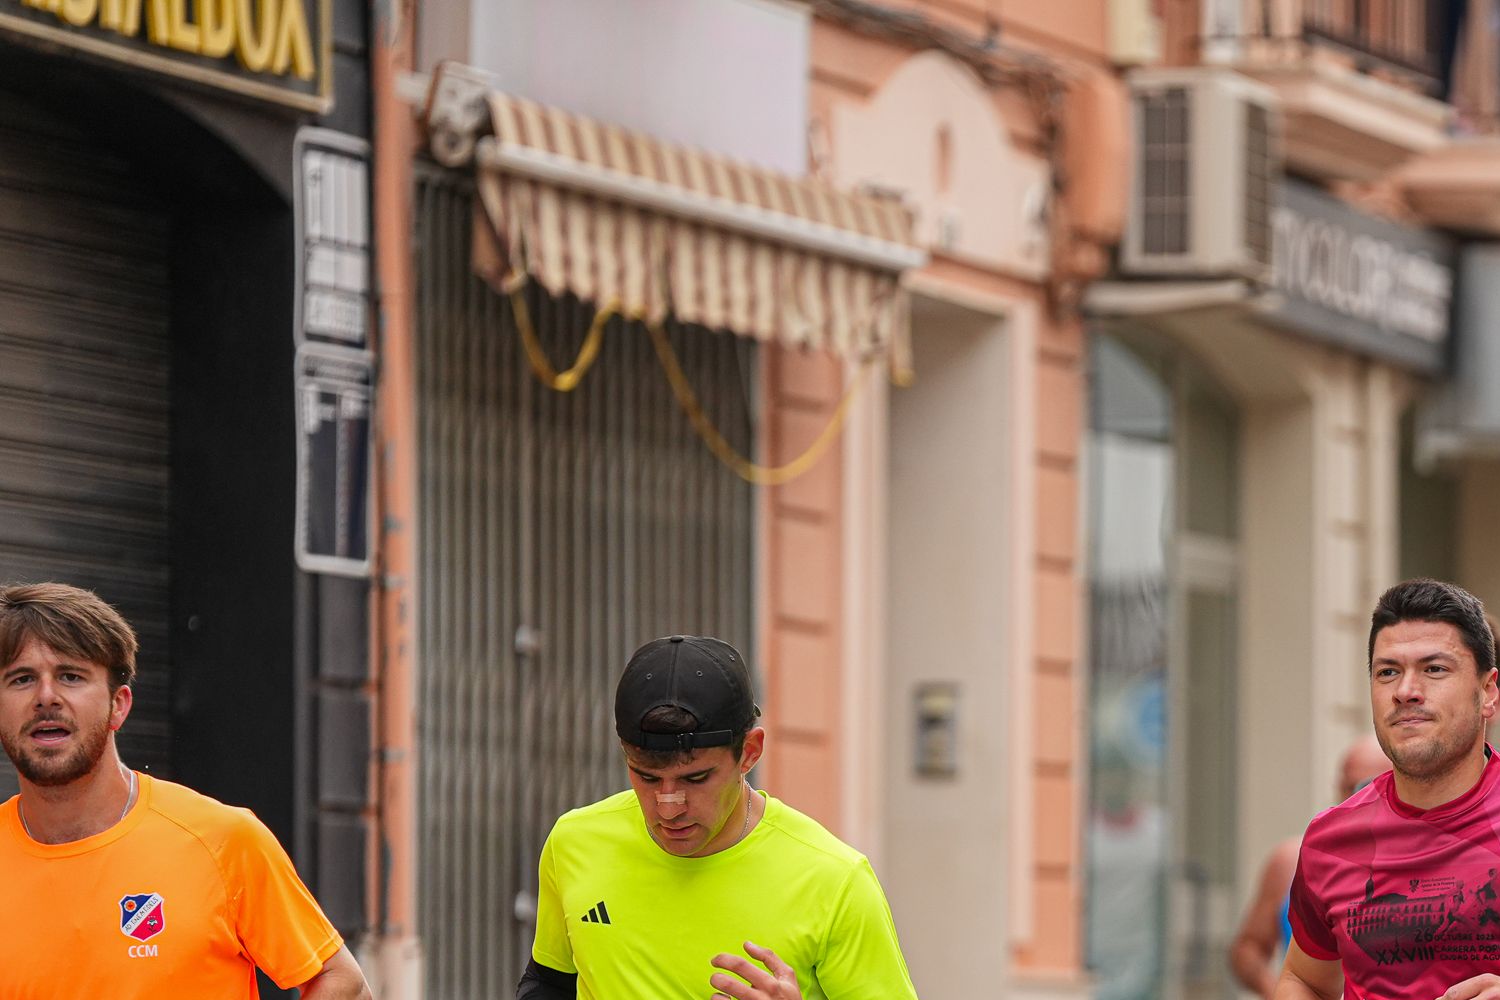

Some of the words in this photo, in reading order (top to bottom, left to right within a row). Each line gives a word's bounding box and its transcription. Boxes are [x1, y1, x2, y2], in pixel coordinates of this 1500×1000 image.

[1415, 929, 1434, 943] 26
[128, 945, 158, 958] CCM
[1376, 945, 1435, 967] XXVIII
